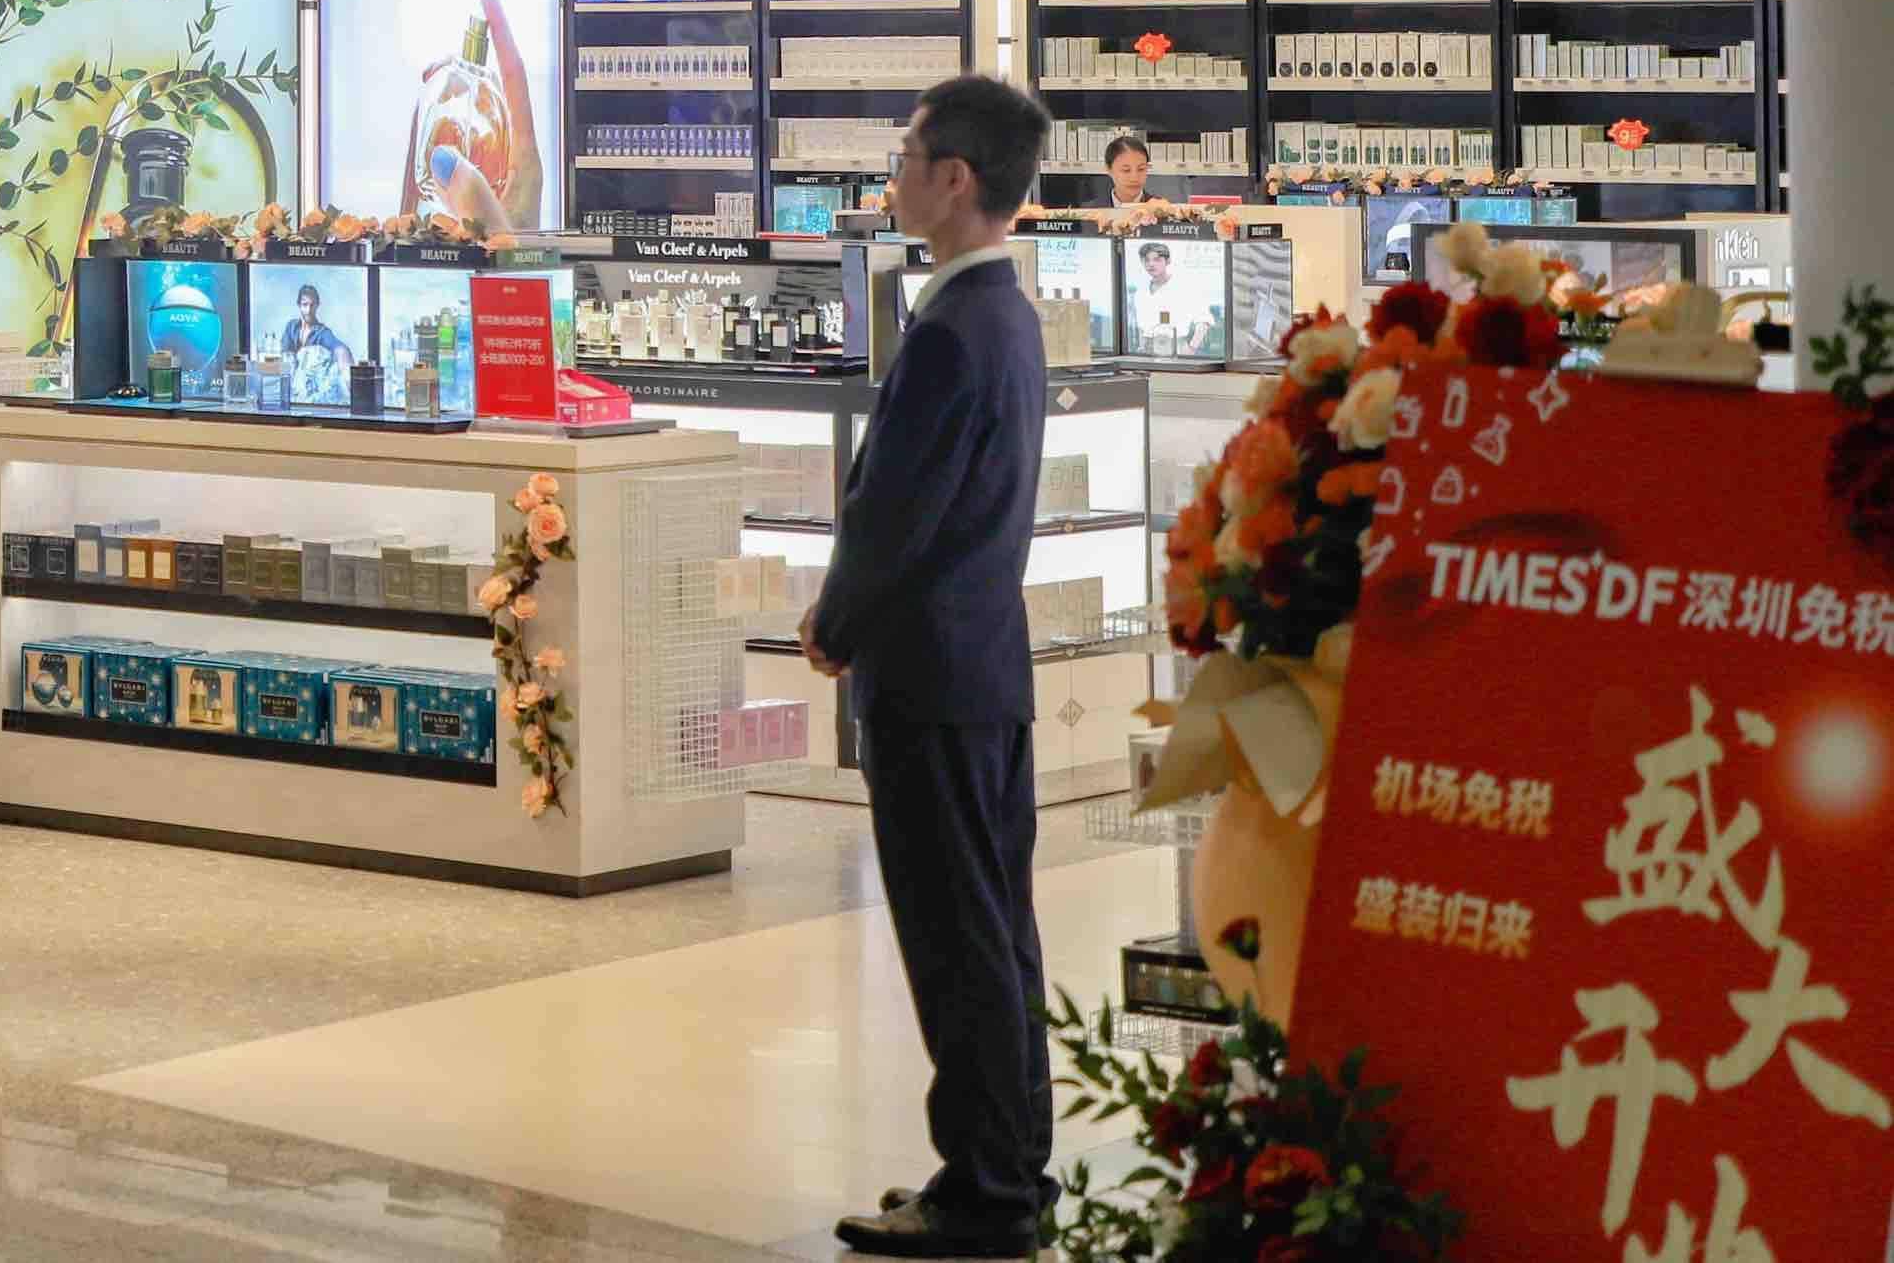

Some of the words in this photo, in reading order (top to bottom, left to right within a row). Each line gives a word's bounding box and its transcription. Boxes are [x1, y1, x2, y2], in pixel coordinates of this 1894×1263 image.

[1037, 222, 1074, 231] BEAUTY
[1162, 225, 1200, 235] BEAUTY
[289, 246, 327, 258] BEAUTY
[420, 250, 459, 260] BEAUTY
[636, 241, 659, 256] Van
[661, 241, 694, 257] Cleef
[697, 245, 706, 256] &
[708, 243, 748, 260] Arpels
[628, 269, 651, 284] Van
[654, 269, 688, 284] Cleef
[690, 272, 699, 284] &
[701, 271, 741, 287] Arpels
[1679, 572, 1894, 656] 深圳免税
[1374, 754, 1554, 838] 机场免税
[1353, 874, 1536, 960] 盛装归来
